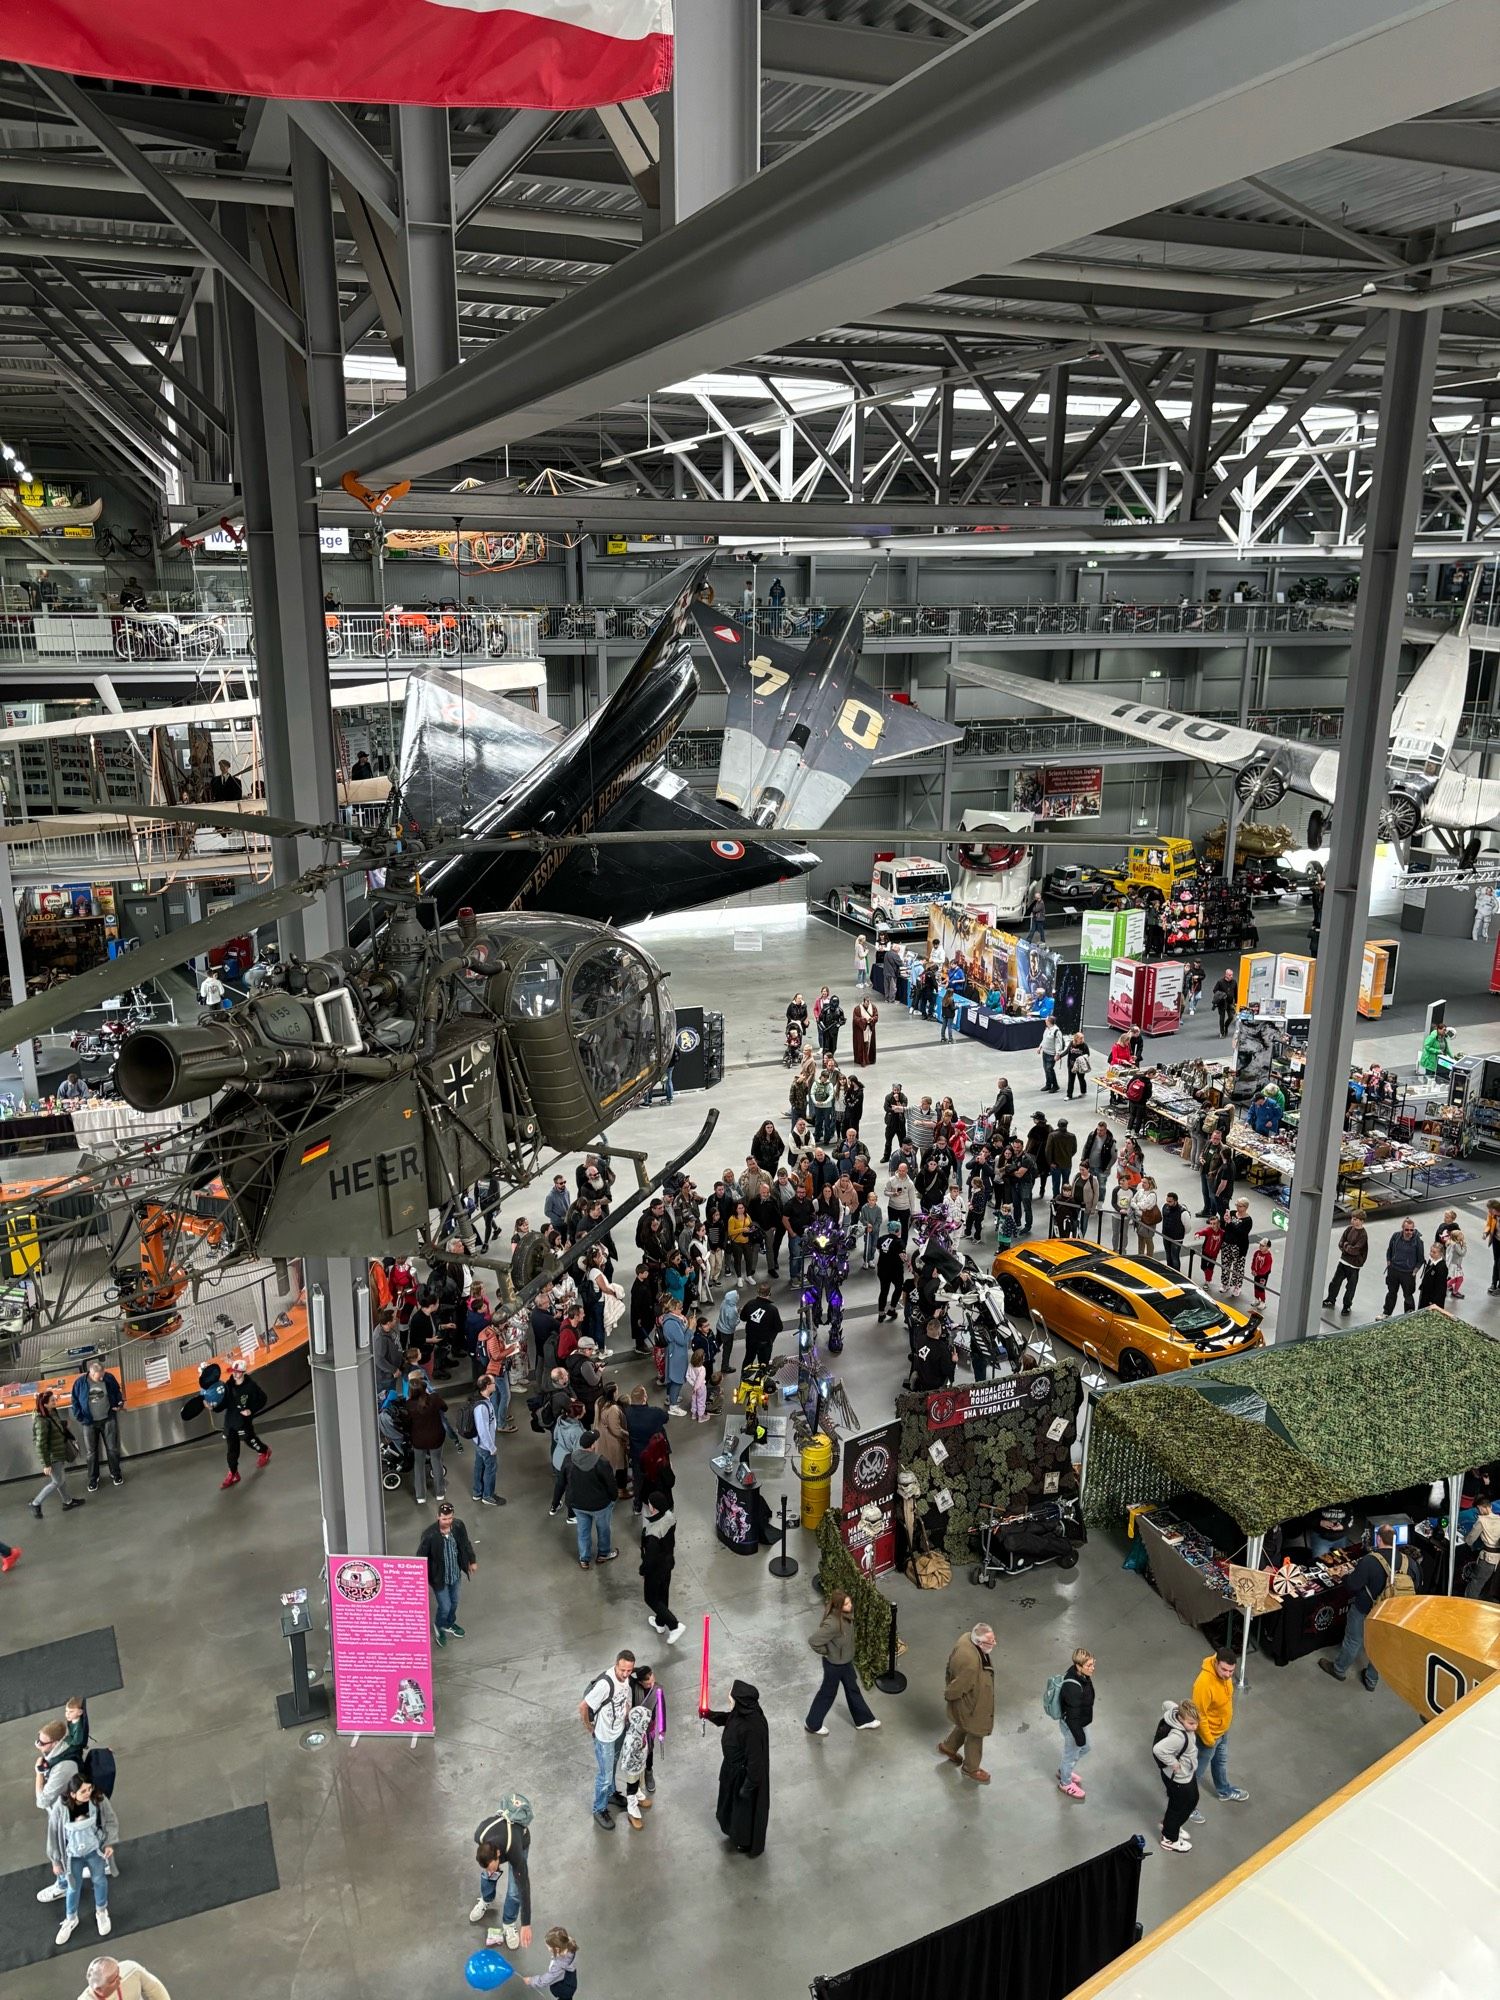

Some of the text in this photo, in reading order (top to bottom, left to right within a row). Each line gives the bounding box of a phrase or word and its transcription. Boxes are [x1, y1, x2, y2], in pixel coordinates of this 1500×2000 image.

[319, 536, 343, 548] age
[534, 827, 578, 895] ESCADE
[581, 806, 594, 833] DE
[329, 1146, 419, 1200] HEER
[969, 1380, 1017, 1397] MANDALORIAN
[970, 1389, 1015, 1405] ROUGHNECKS
[963, 1400, 1020, 1419] DHA VERDA CLAN
[847, 1508, 858, 1519] DHA
[878, 1493, 894, 1505] CLAN
